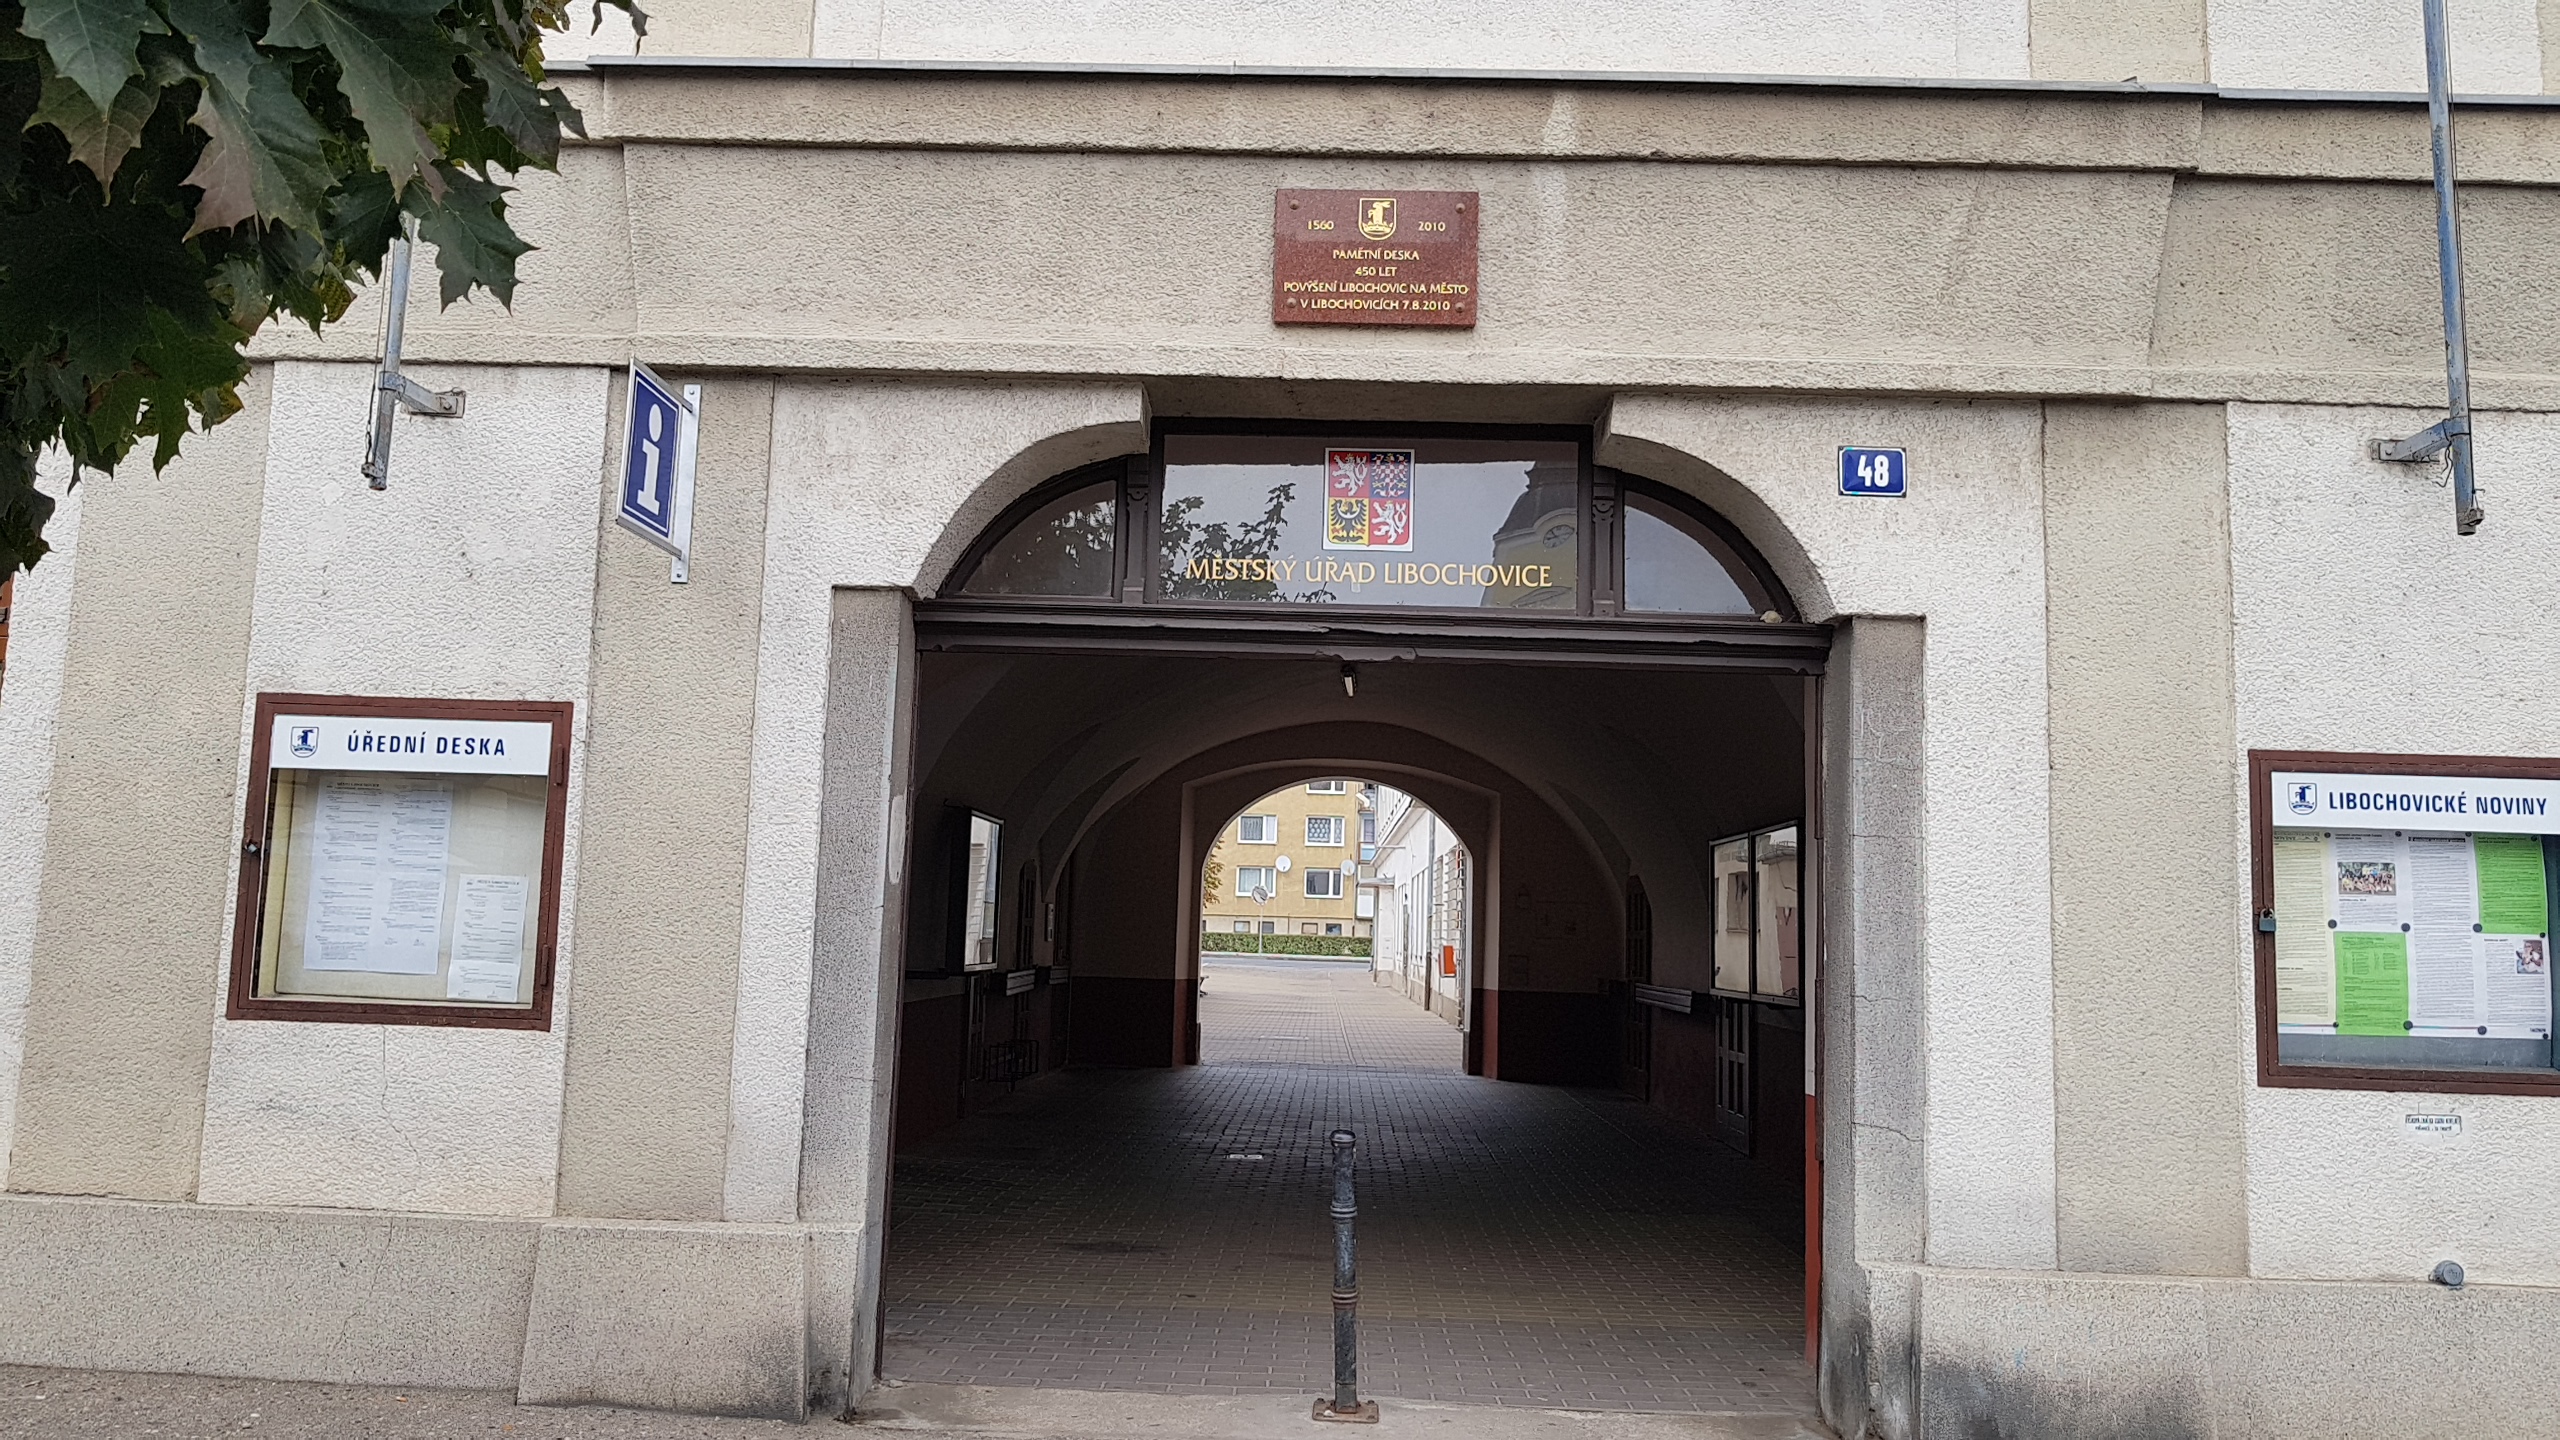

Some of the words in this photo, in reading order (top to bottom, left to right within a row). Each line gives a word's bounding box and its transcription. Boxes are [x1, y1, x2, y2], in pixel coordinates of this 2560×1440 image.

[1307, 220, 1335, 231] 1560
[1418, 221, 1446, 232] 2010
[1332, 247, 1382, 260] PAMĚTNÍ
[1383, 250, 1420, 260] DESKA
[1355, 266, 1377, 276] 450
[1378, 266, 1398, 277] LET
[1283, 280, 1338, 293] POVÝŠENÍ
[1339, 282, 1408, 294] LIBOCHOVIC
[1409, 283, 1427, 294] NA
[1429, 281, 1470, 295] MĚSTO
[1300, 298, 1310, 309] V
[1311, 297, 1400, 311] LIBOCHOVICÍCH
[1402, 300, 1451, 311] 7.8.2010
[1857, 454, 1890, 488] 48
[1185, 552, 1298, 582] MĚSTSKÝ
[1305, 554, 1377, 584] ÚŘAD
[1383, 561, 1554, 588] LIBOCHOVICE
[347, 729, 427, 754] ÚŘEDNÍ
[436, 736, 505, 757] DESKA
[2328, 790, 2468, 814] LIBOCHOVICKÉ
[2476, 796, 2548, 816] NOVINY
